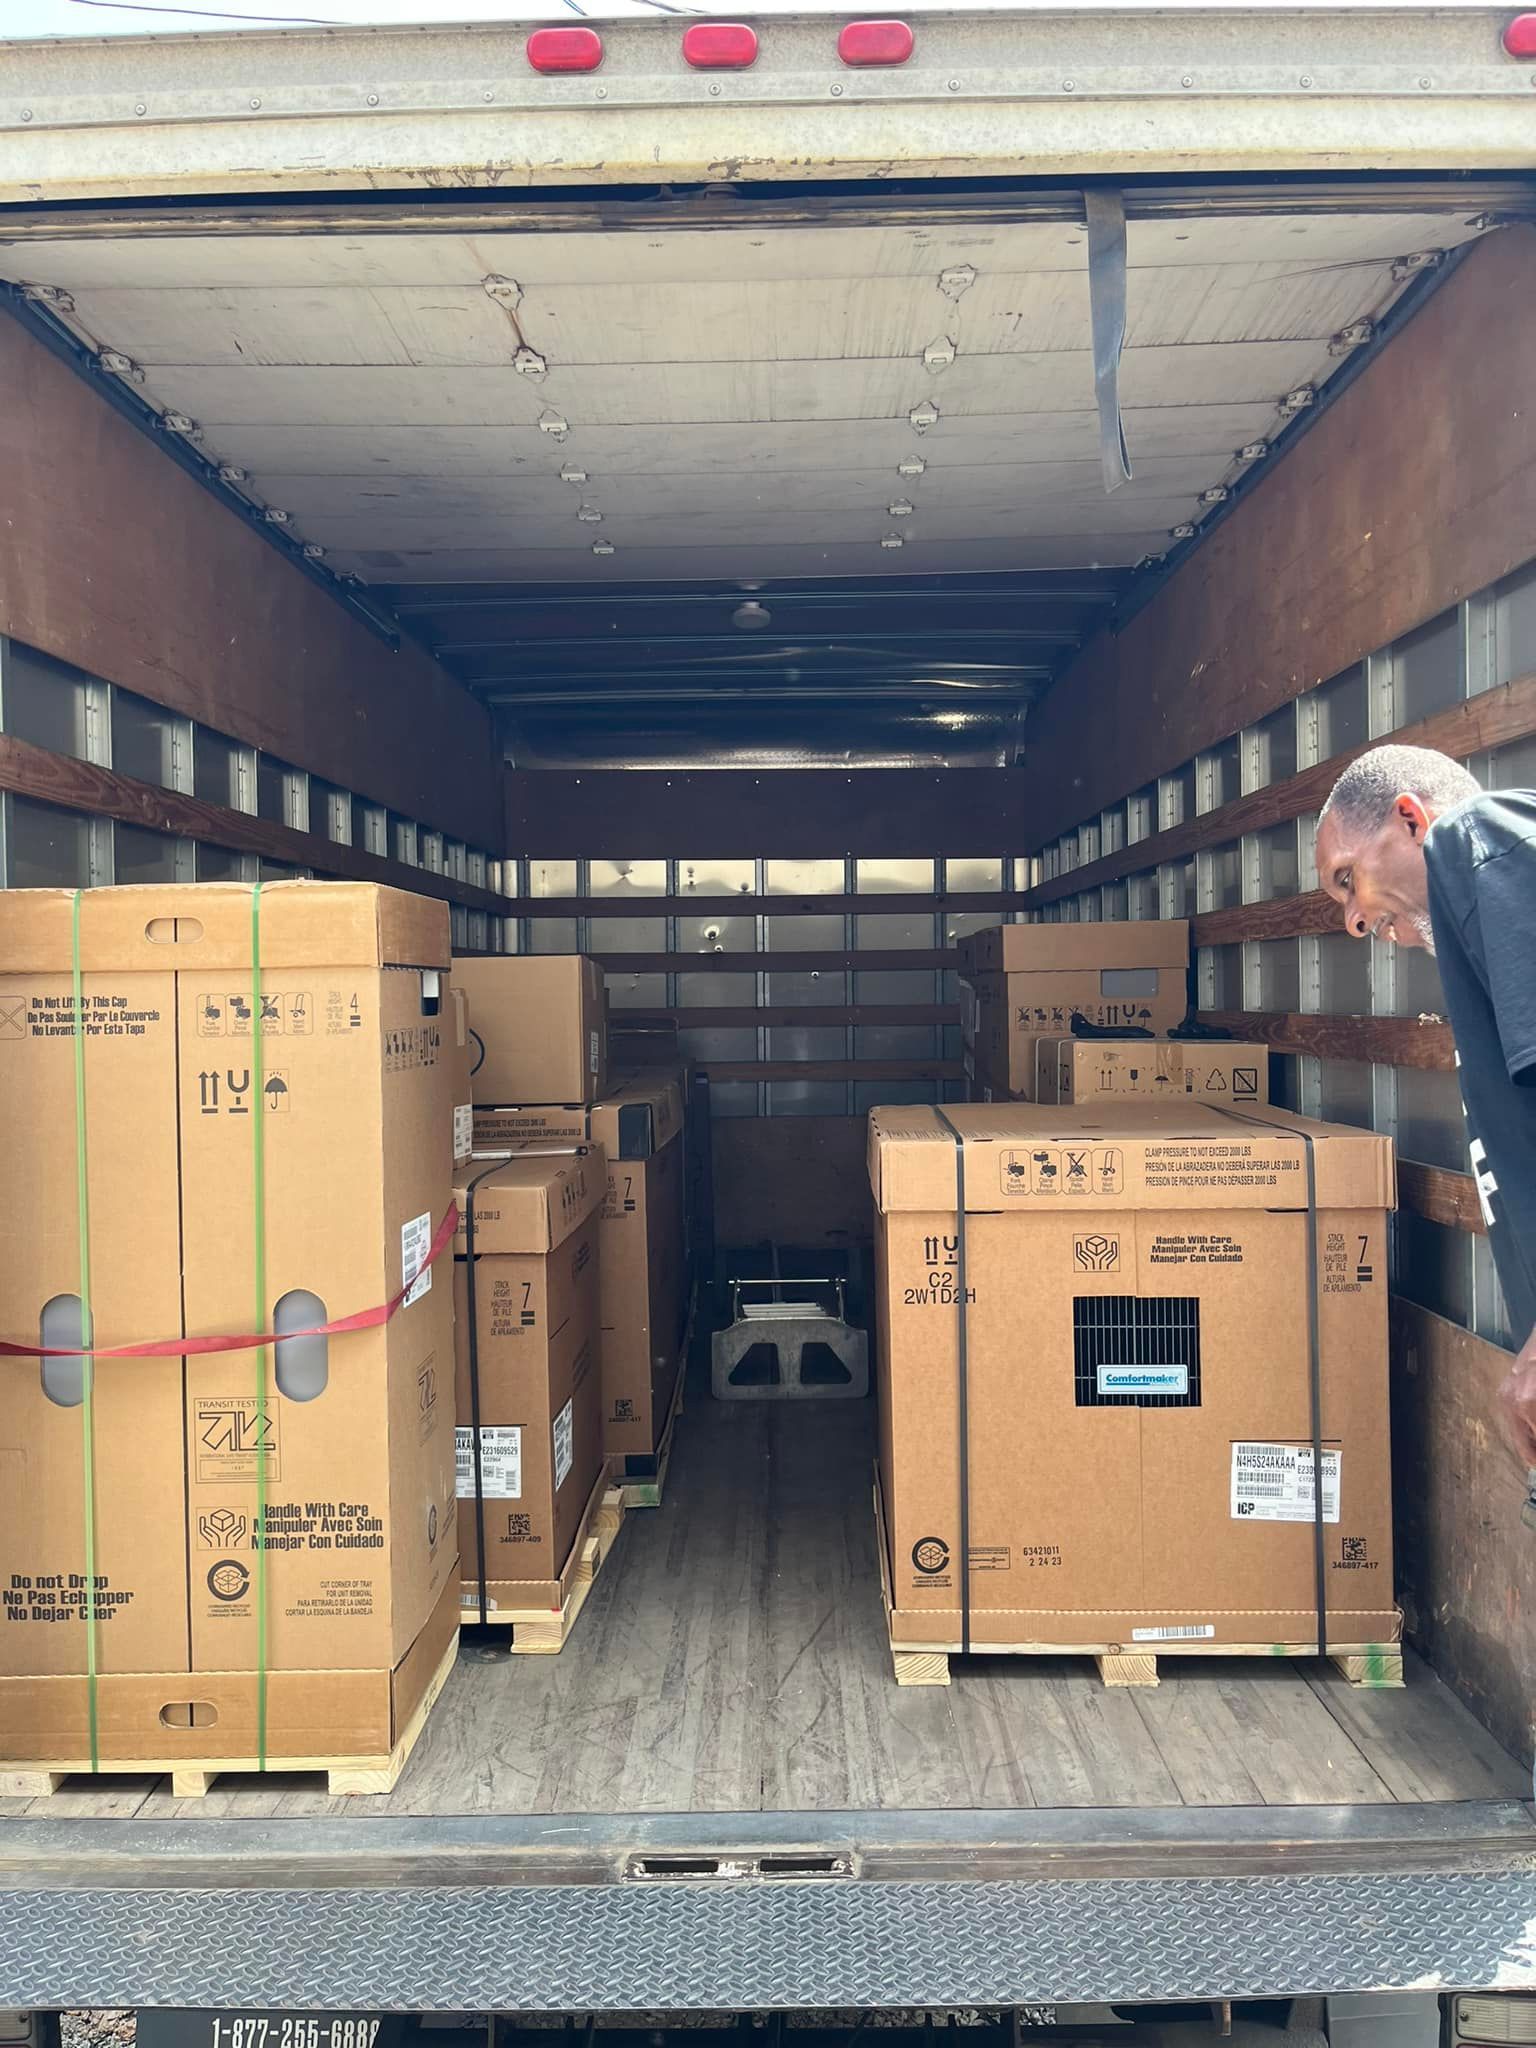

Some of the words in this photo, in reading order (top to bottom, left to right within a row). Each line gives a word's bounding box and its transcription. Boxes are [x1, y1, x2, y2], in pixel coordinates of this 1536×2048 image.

[32, 997, 43, 1009] Do
[45, 997, 60, 1009] Not
[93, 996, 110, 1008] This
[112, 996, 128, 1008] Cap
[350, 992, 358, 1013] 4
[40, 1012, 54, 1023] Pas
[56, 1011, 91, 1023] Souleer
[93, 1011, 108, 1022] Par
[109, 1011, 119, 1022] Le
[32, 1025, 43, 1036] No
[45, 1025, 85, 1036] Levant
[87, 1024, 102, 1035] Por
[104, 1024, 123, 1035] Esta
[125, 1023, 145, 1035] Tapa
[1144, 1147, 1162, 1158] CLAMP
[1163, 1147, 1190, 1157] PRESSURE
[1190, 1146, 1197, 1157] TO
[1198, 1146, 1208, 1157] NOT
[1209, 1146, 1229, 1157] EXCEED
[1241, 1145, 1252, 1156] LBS
[1168, 1161, 1175, 1172] DE
[1175, 1161, 1182, 1172] LA
[1217, 1160, 1225, 1171] NO
[1246, 1160, 1270, 1171] SUPERAR
[1270, 1160, 1281, 1170] LAS
[1145, 1176, 1171, 1186] PRESSION
[1171, 1176, 1178, 1186] DE
[1194, 1175, 1209, 1186] POUR
[1210, 1175, 1217, 1186] NE
[1217, 1175, 1228, 1186] PAS
[1266, 1174, 1277, 1185] LBS
[624, 1176, 632, 1199] 7
[1155, 1236, 1186, 1245] Handle
[1187, 1235, 1208, 1244] With
[1210, 1235, 1232, 1244] Care
[1151, 1245, 1197, 1254] Manipuler
[1199, 1244, 1221, 1253] Avec
[1222, 1243, 1242, 1252] Soin
[1358, 1235, 1368, 1264] 7
[1150, 1254, 1188, 1264] Manejar
[1190, 1254, 1206, 1263] Con
[1208, 1253, 1243, 1263] Cuidado
[928, 1272, 953, 1288] C2
[521, 1282, 531, 1309] 7
[904, 1288, 976, 1305] 2W1D2H
[1106, 1373, 1179, 1384] Comfortmaker
[198, 1400, 234, 1409] TRANSIT
[236, 1400, 269, 1408] TESTD
[1236, 1455, 1296, 1470] N4H5S24AKAAA
[1297, 1464, 1337, 1476] E2308950
[305, 1502, 336, 1518] With
[339, 1502, 369, 1517] Care
[1237, 1502, 1255, 1515] ICP
[253, 1518, 317, 1535] Manipuler
[321, 1517, 353, 1532] Avec
[356, 1516, 383, 1532] Soin
[251, 1535, 305, 1551] Manejar
[308, 1534, 332, 1549] Con
[335, 1533, 384, 1548] Cuidado
[1023, 1546, 1060, 1556] 63421011
[1029, 1558, 1035, 1567] 2
[1038, 1557, 1049, 1566] 24
[1052, 1556, 1062, 1566] 23
[11, 1574, 32, 1589] Do
[36, 1574, 64, 1589] not
[320, 1580, 330, 1589] CUT
[331, 1580, 351, 1589] CORNER
[352, 1580, 359, 1588] OF
[3, 1590, 23, 1605] Ne
[27, 1590, 56, 1605] Pas
[60, 1590, 135, 1606] Echpper
[326, 1590, 337, 1598] FOR
[8, 1606, 28, 1621] No
[32, 1606, 75, 1622] Dejar
[79, 1605, 117, 1620] Cer
[212, 2018, 381, 2048] 1-877-255-6888
